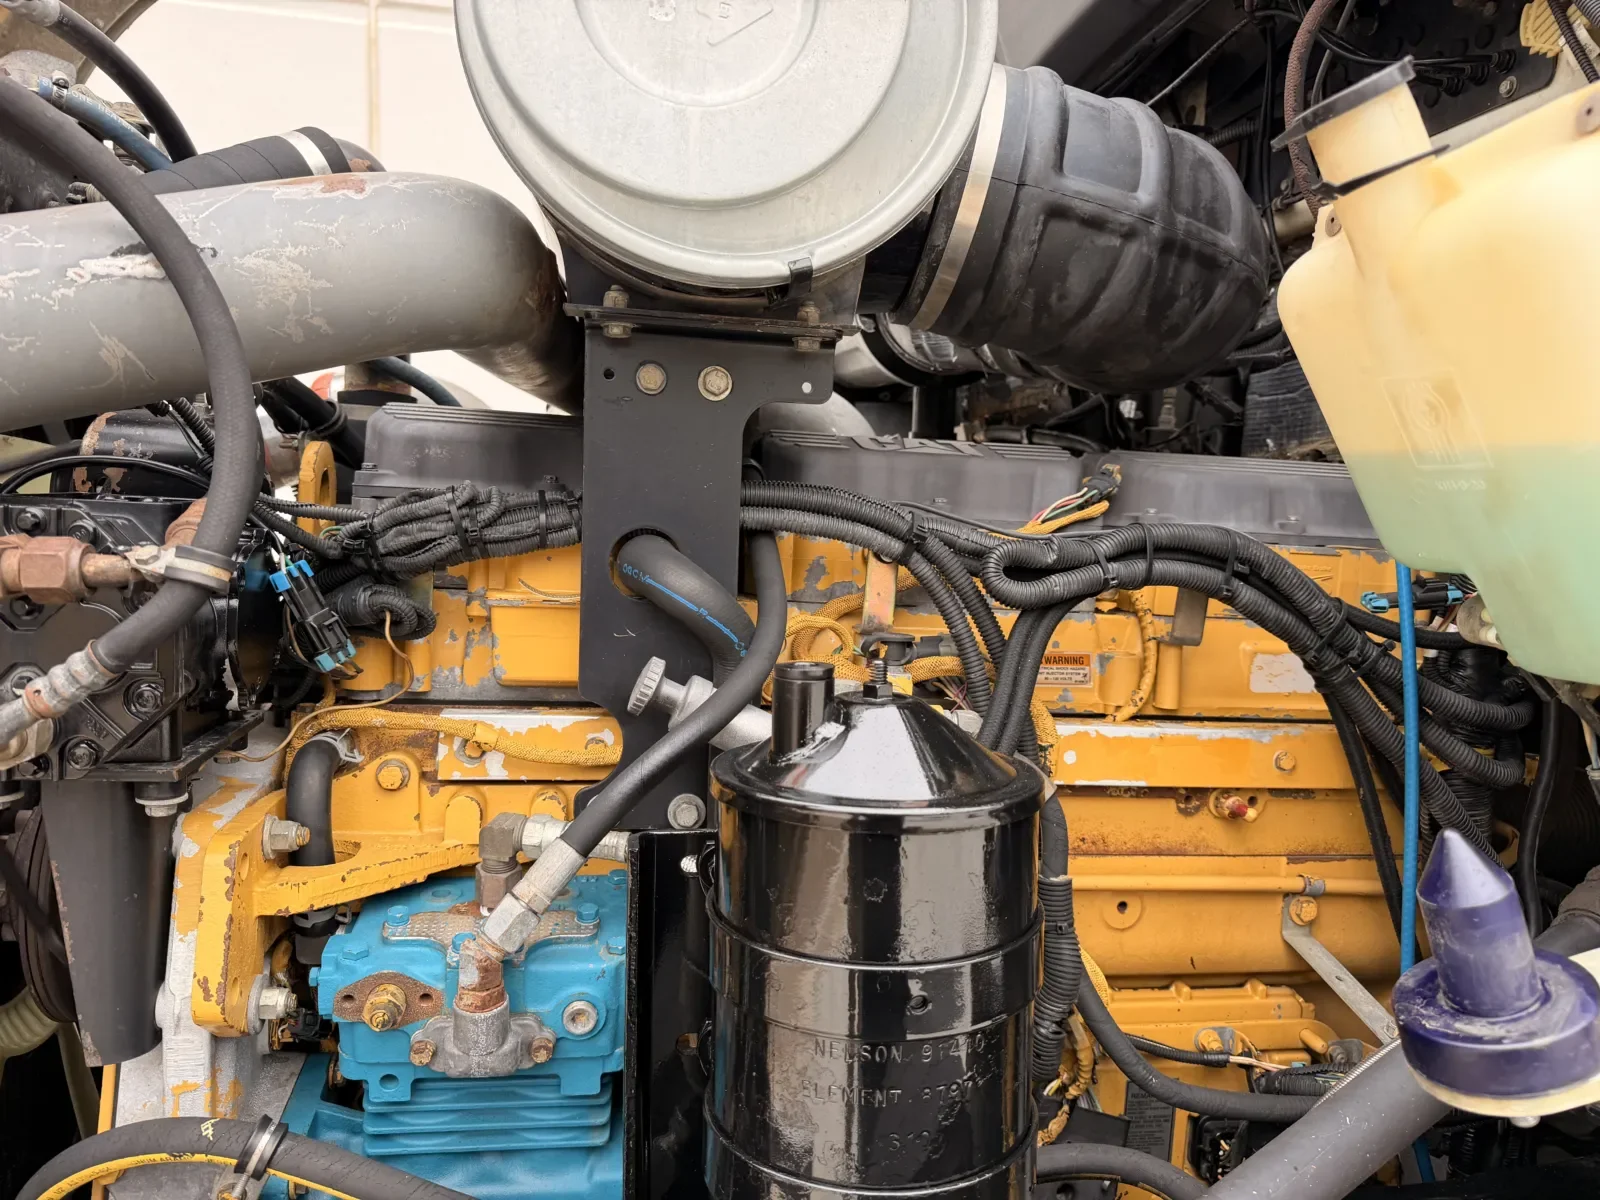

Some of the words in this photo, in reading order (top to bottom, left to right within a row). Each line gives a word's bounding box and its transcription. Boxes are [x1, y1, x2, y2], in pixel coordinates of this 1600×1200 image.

[851, 435, 984, 458] CAT
[1044, 656, 1084, 665] WARNING
[813, 1036, 904, 1063] NELSON
[800, 1079, 903, 1108] ELEMENT
